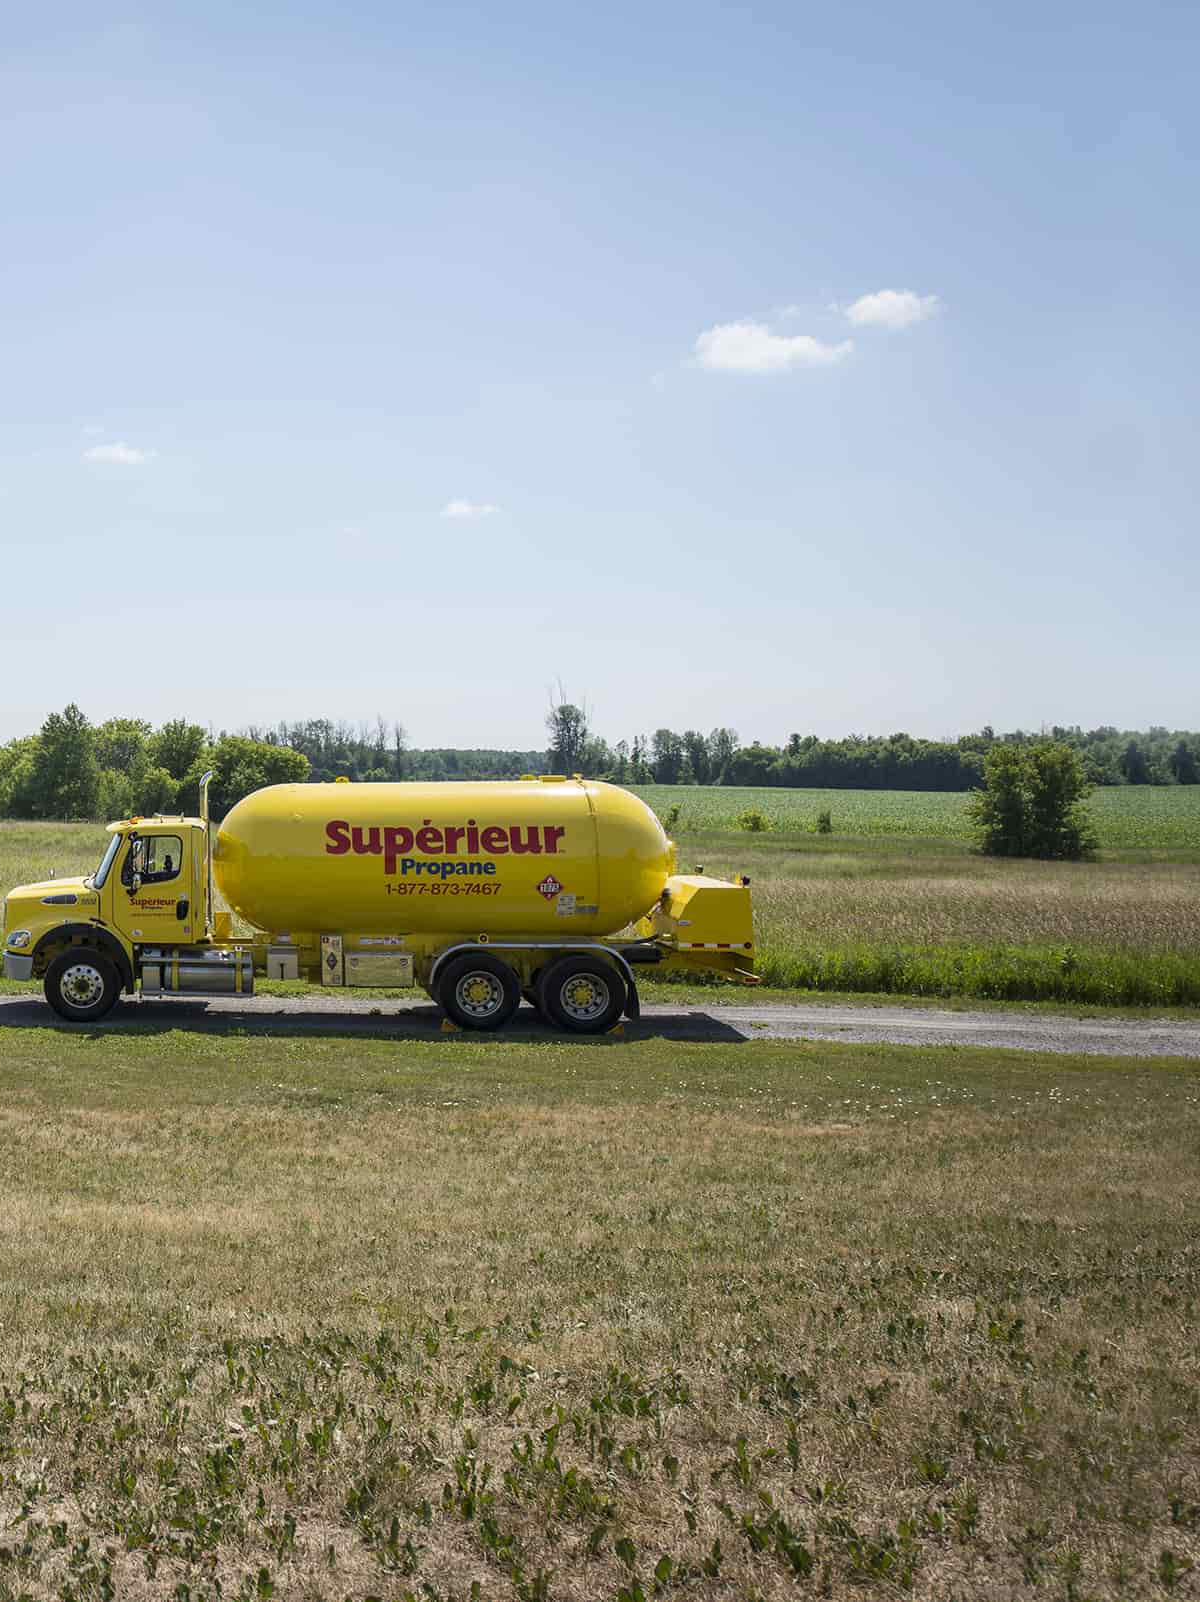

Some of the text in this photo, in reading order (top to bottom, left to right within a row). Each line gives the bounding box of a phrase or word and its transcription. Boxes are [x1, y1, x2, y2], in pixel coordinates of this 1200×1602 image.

[325, 819, 565, 875] Supérieur
[400, 858, 496, 880] Propane
[384, 882, 502, 895] 1-877-873-7467
